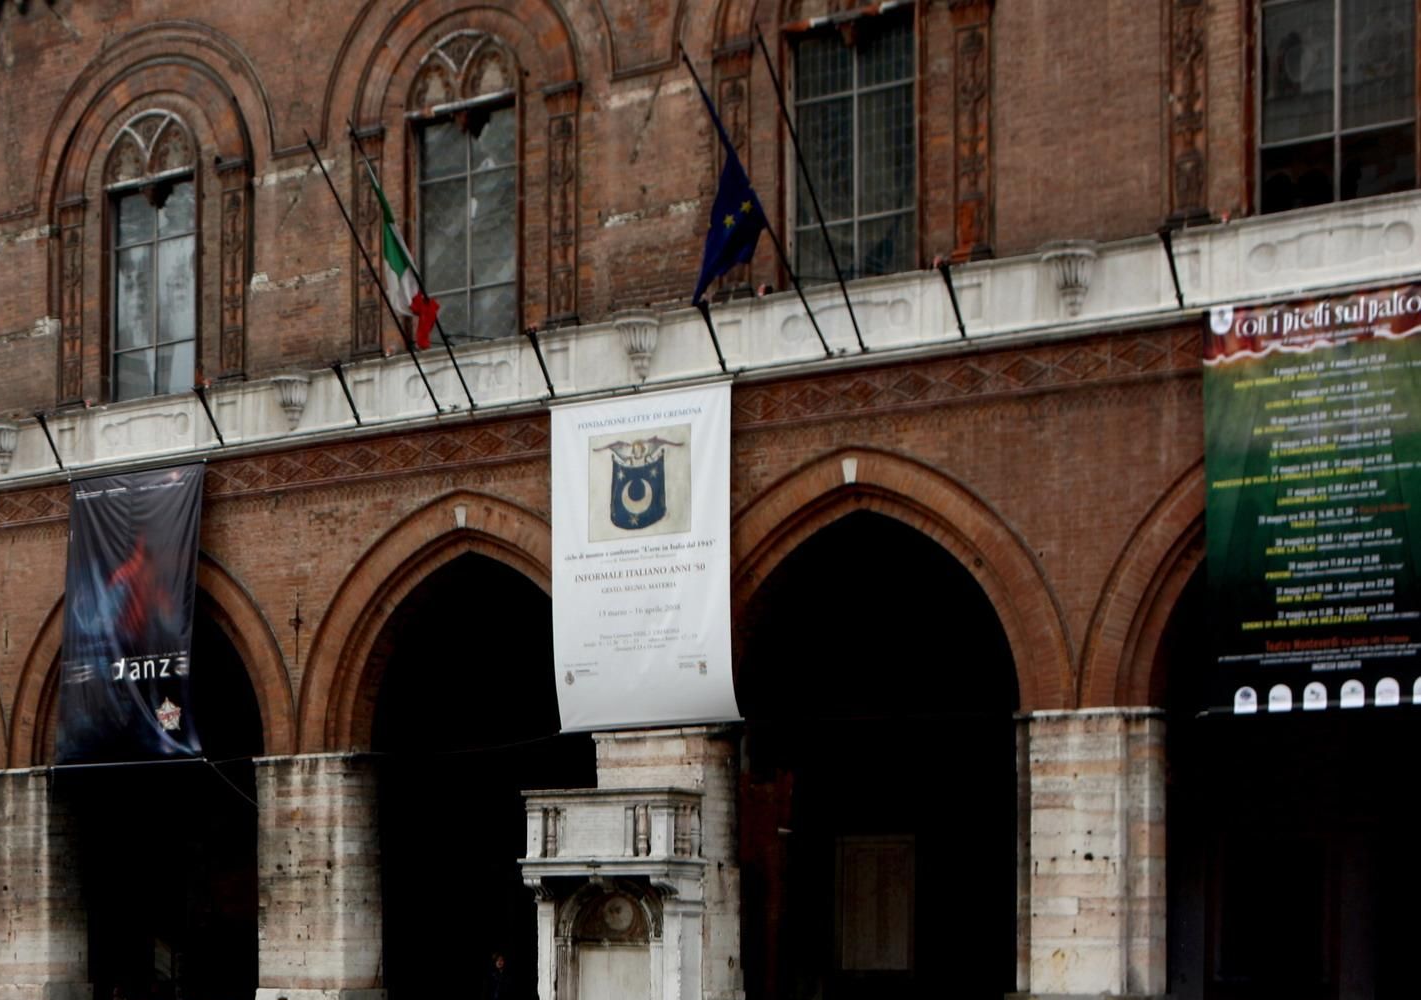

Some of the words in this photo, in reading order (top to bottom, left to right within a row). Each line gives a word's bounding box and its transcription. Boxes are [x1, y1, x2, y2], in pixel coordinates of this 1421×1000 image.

[1235, 316, 1267, 337] con
[1273, 310, 1279, 334] i
[1284, 303, 1330, 335] piedi
[1335, 296, 1364, 324] sul
[575, 570, 623, 583] INFORMALE
[626, 567, 668, 578] ITALIANO
[670, 564, 692, 574] ANNI
